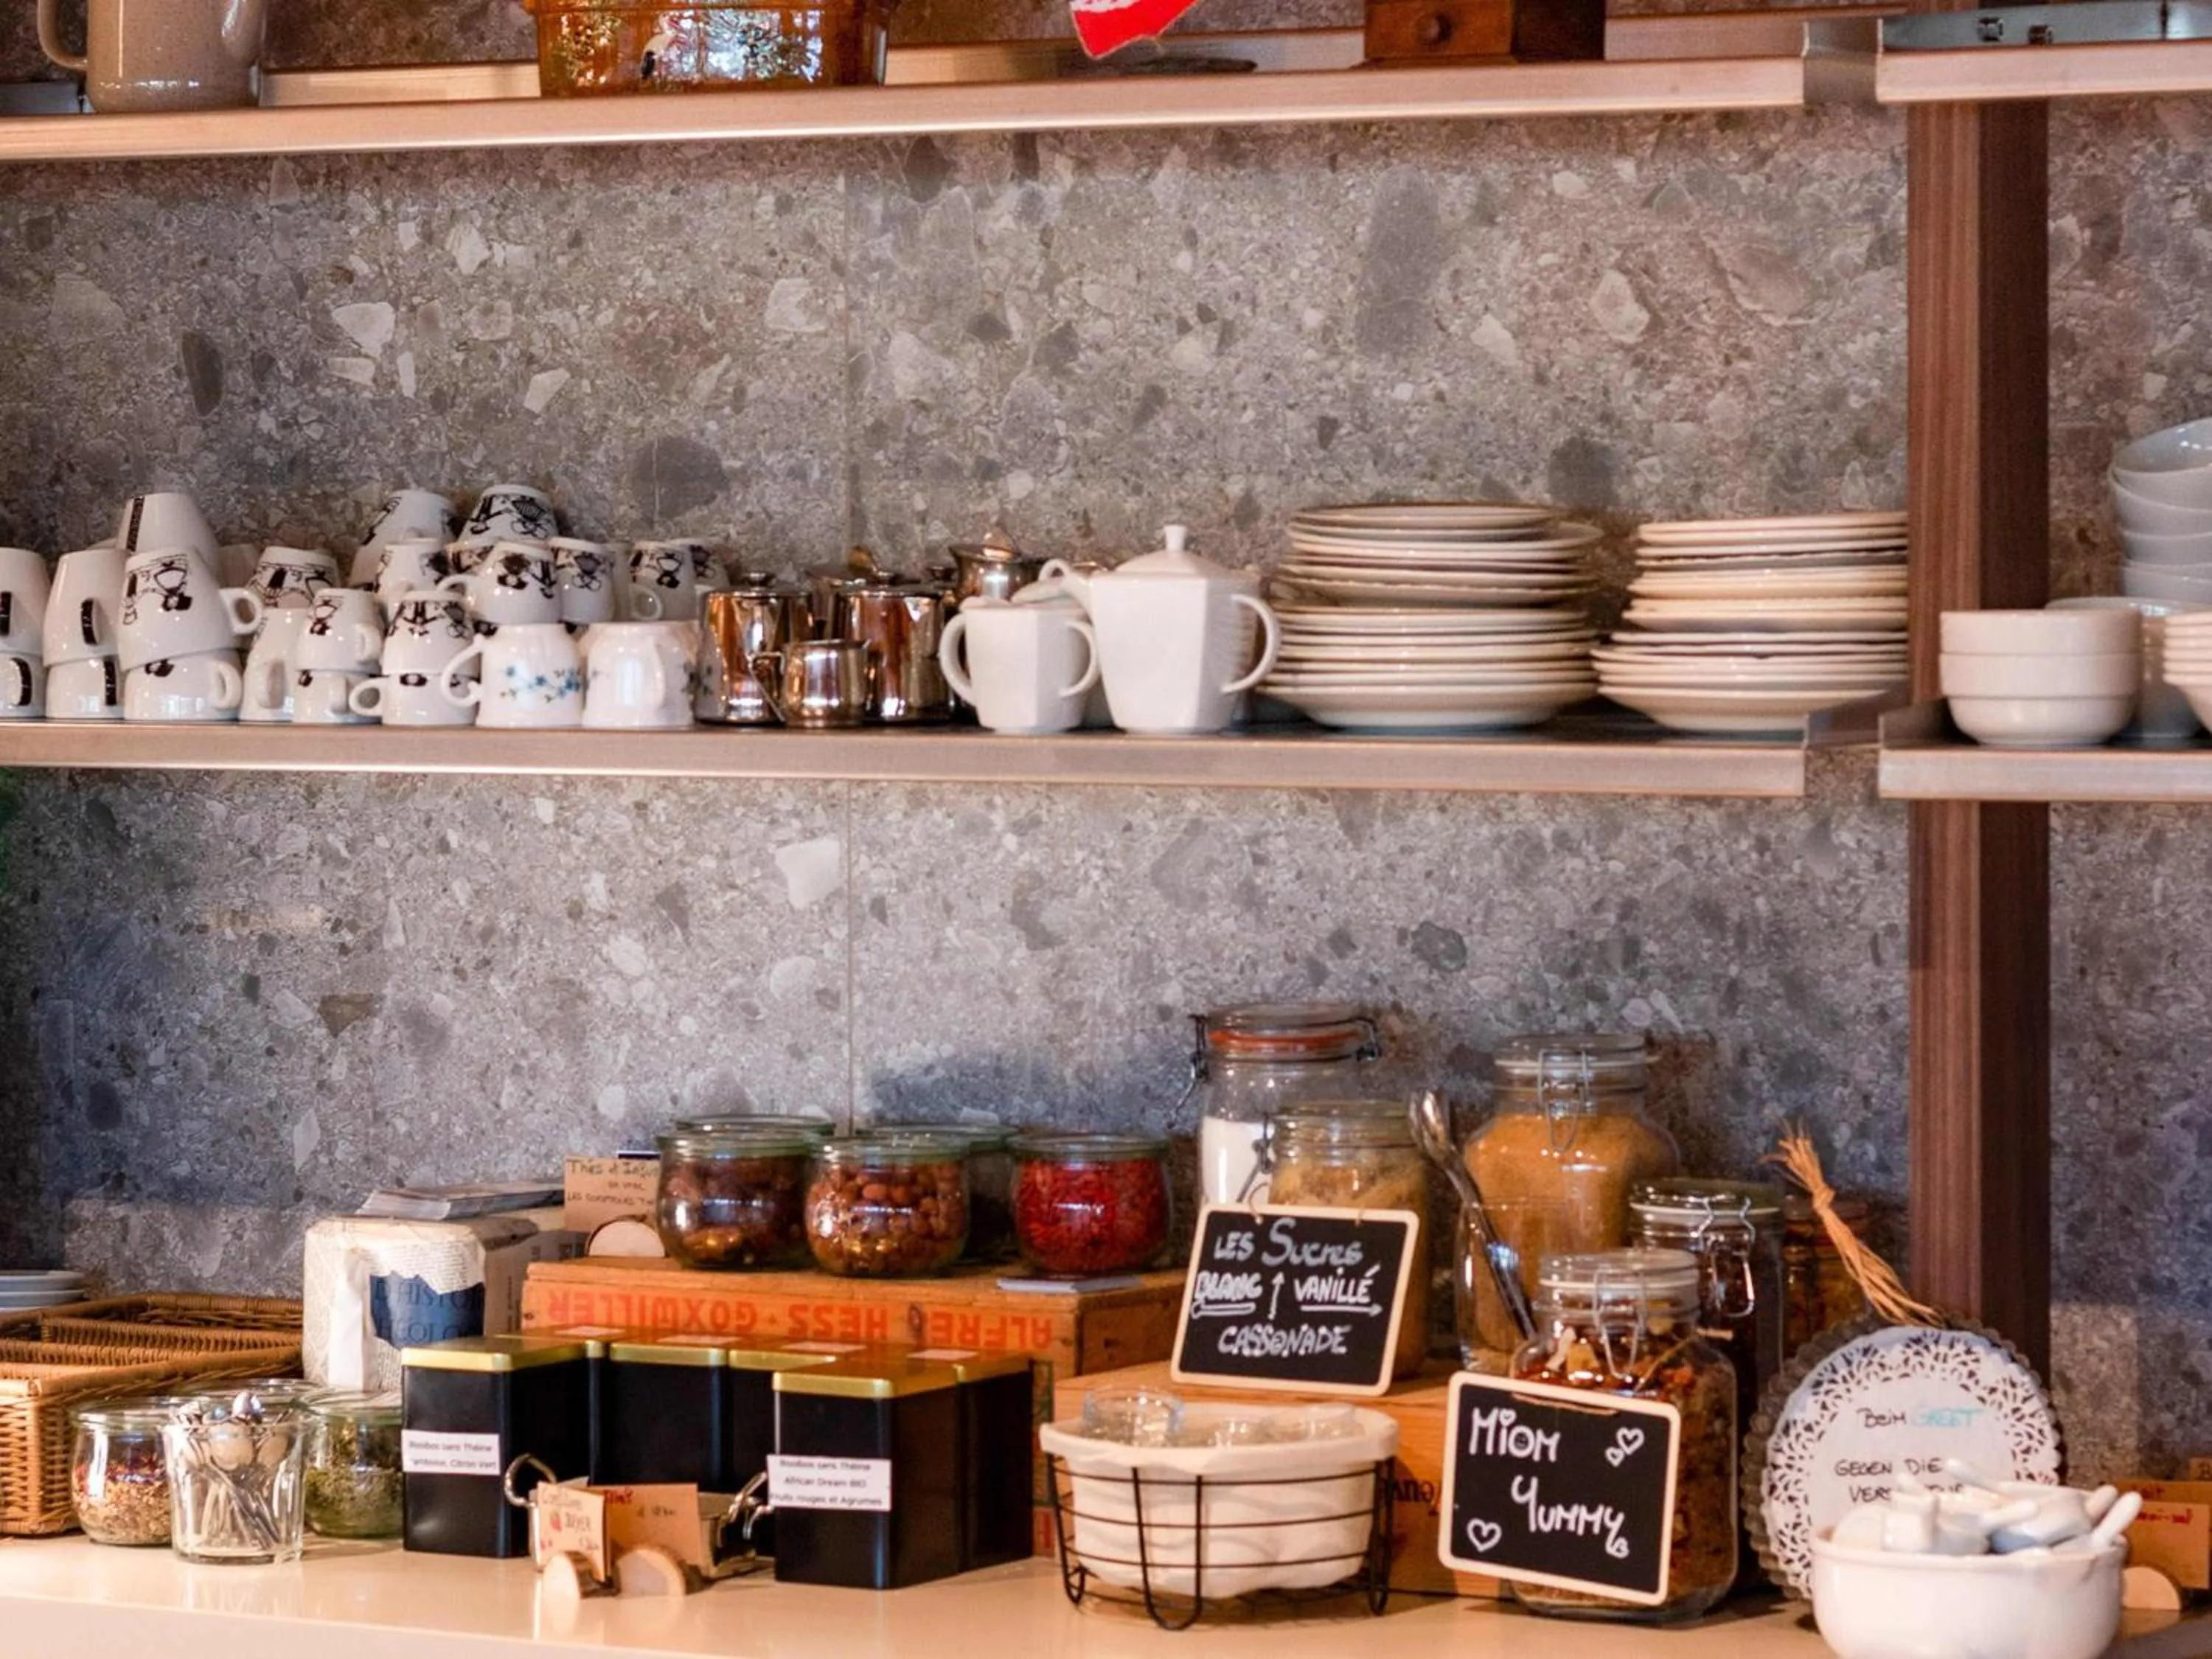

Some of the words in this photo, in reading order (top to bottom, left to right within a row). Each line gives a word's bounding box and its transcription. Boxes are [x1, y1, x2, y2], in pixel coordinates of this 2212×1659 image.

[1214, 1231, 1255, 1261] LES
[548, 1291, 758, 1332] GOXWILLER
[787, 1304, 889, 1342] HESS
[908, 1304, 1052, 1349] ALFRE
